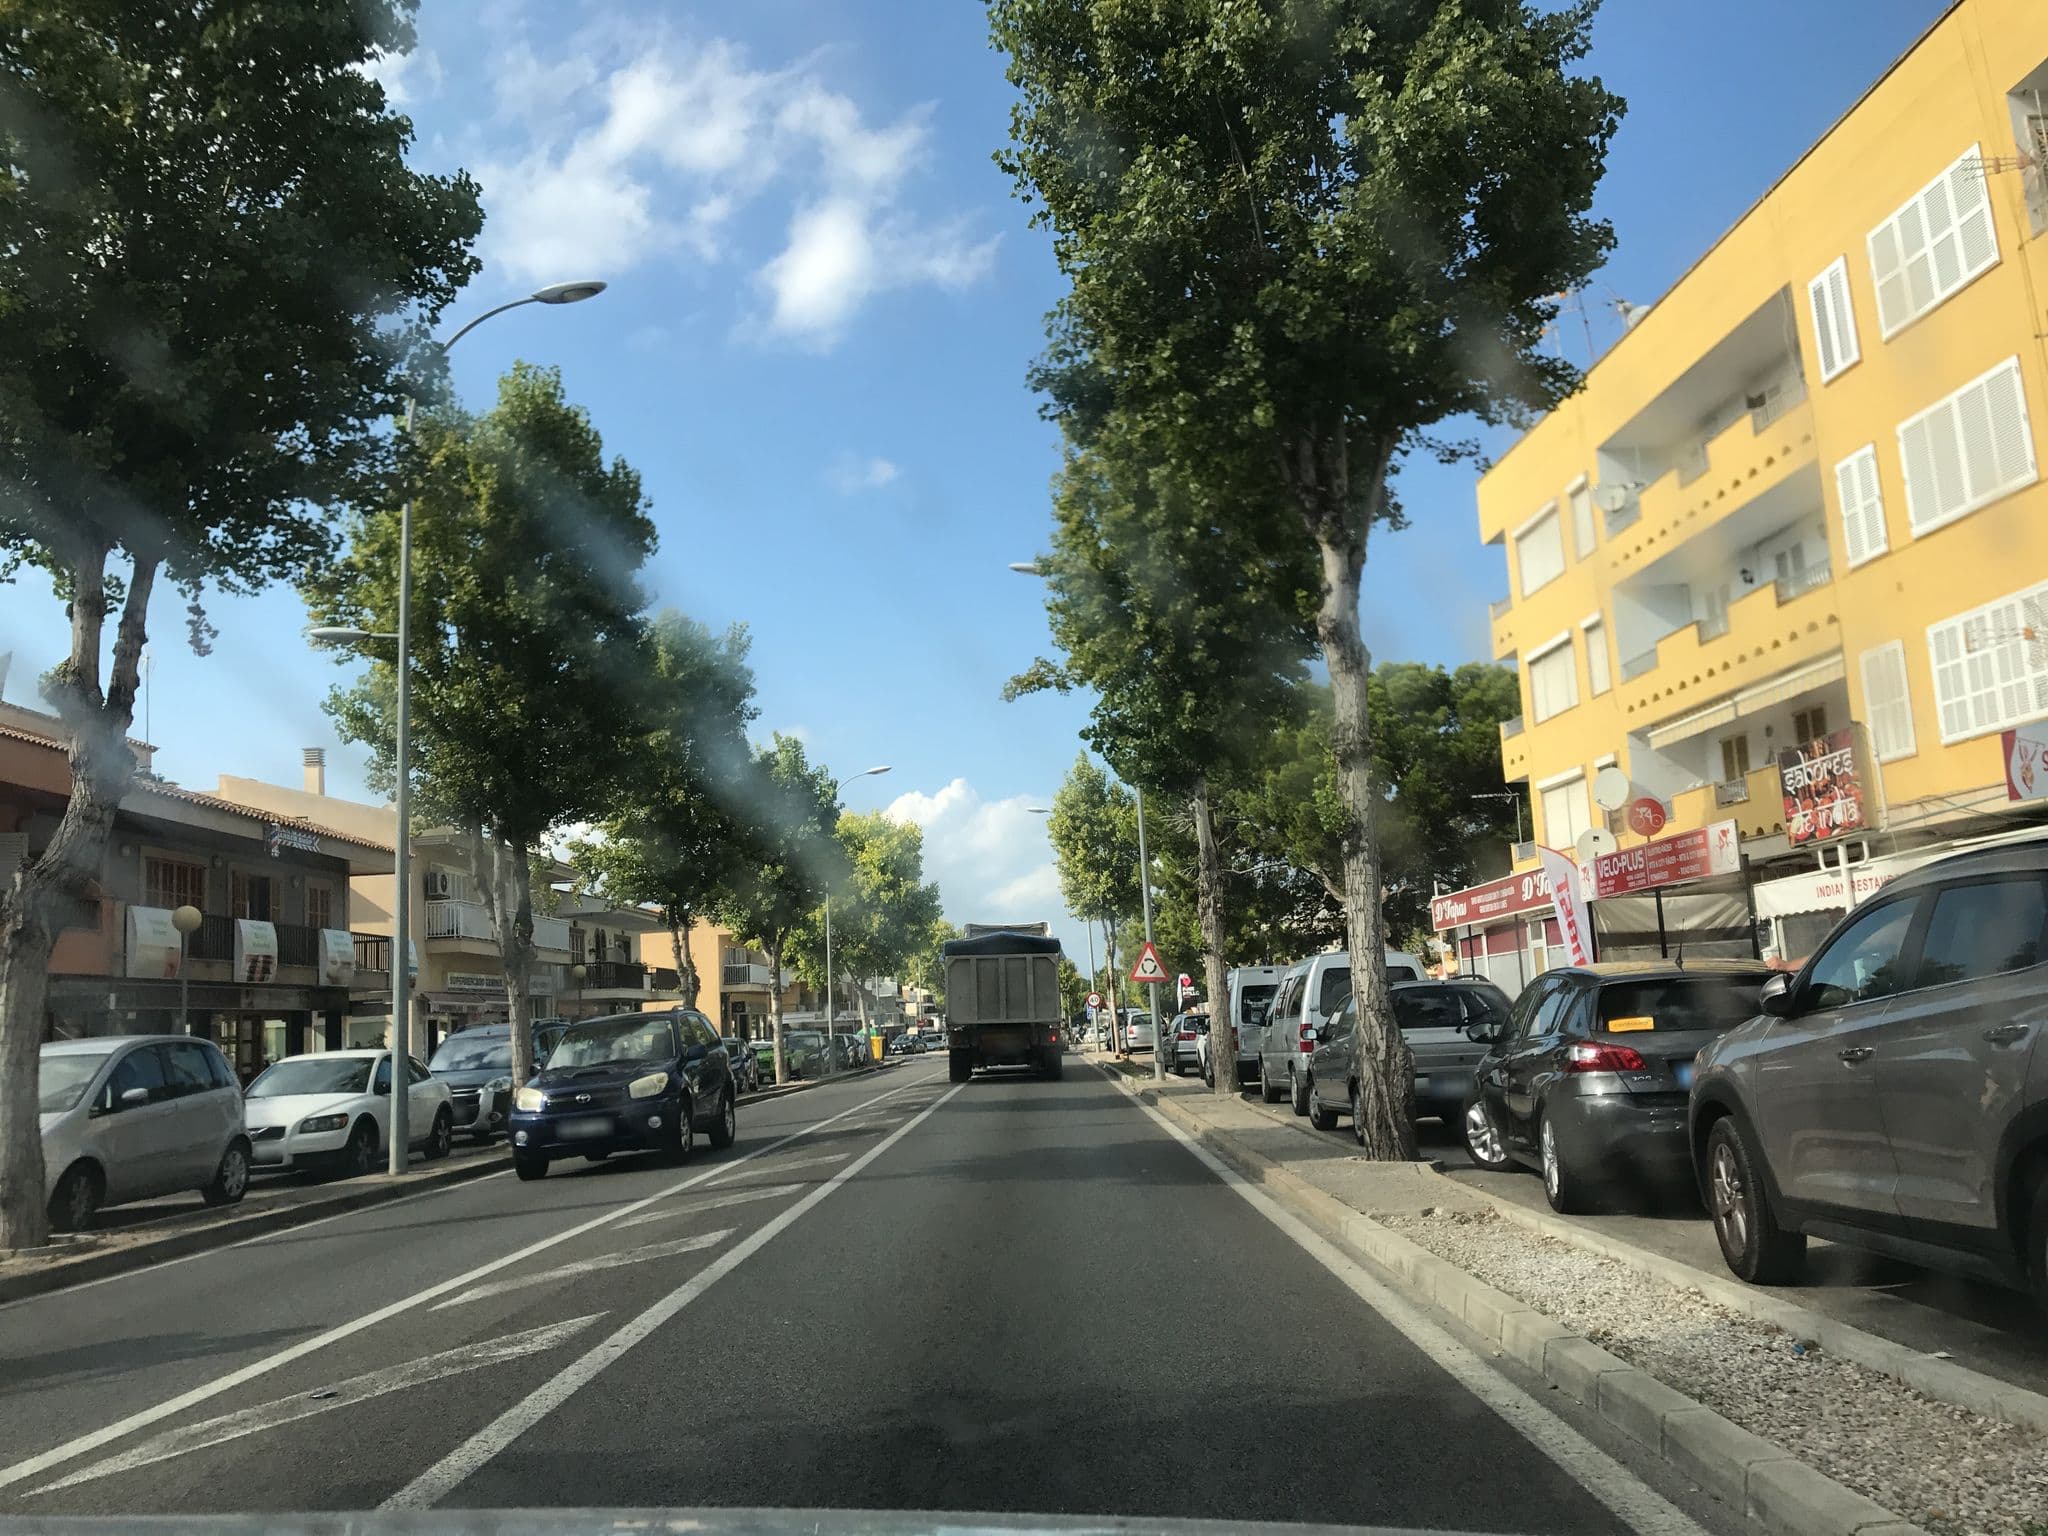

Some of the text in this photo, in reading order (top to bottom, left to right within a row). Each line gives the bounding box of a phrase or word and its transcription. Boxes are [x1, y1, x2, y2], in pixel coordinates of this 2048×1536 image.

[1792, 798, 1815, 834] de
[1597, 850, 1645, 878] VELO-PLUS
[1435, 899, 1467, 924] D'Tapas
